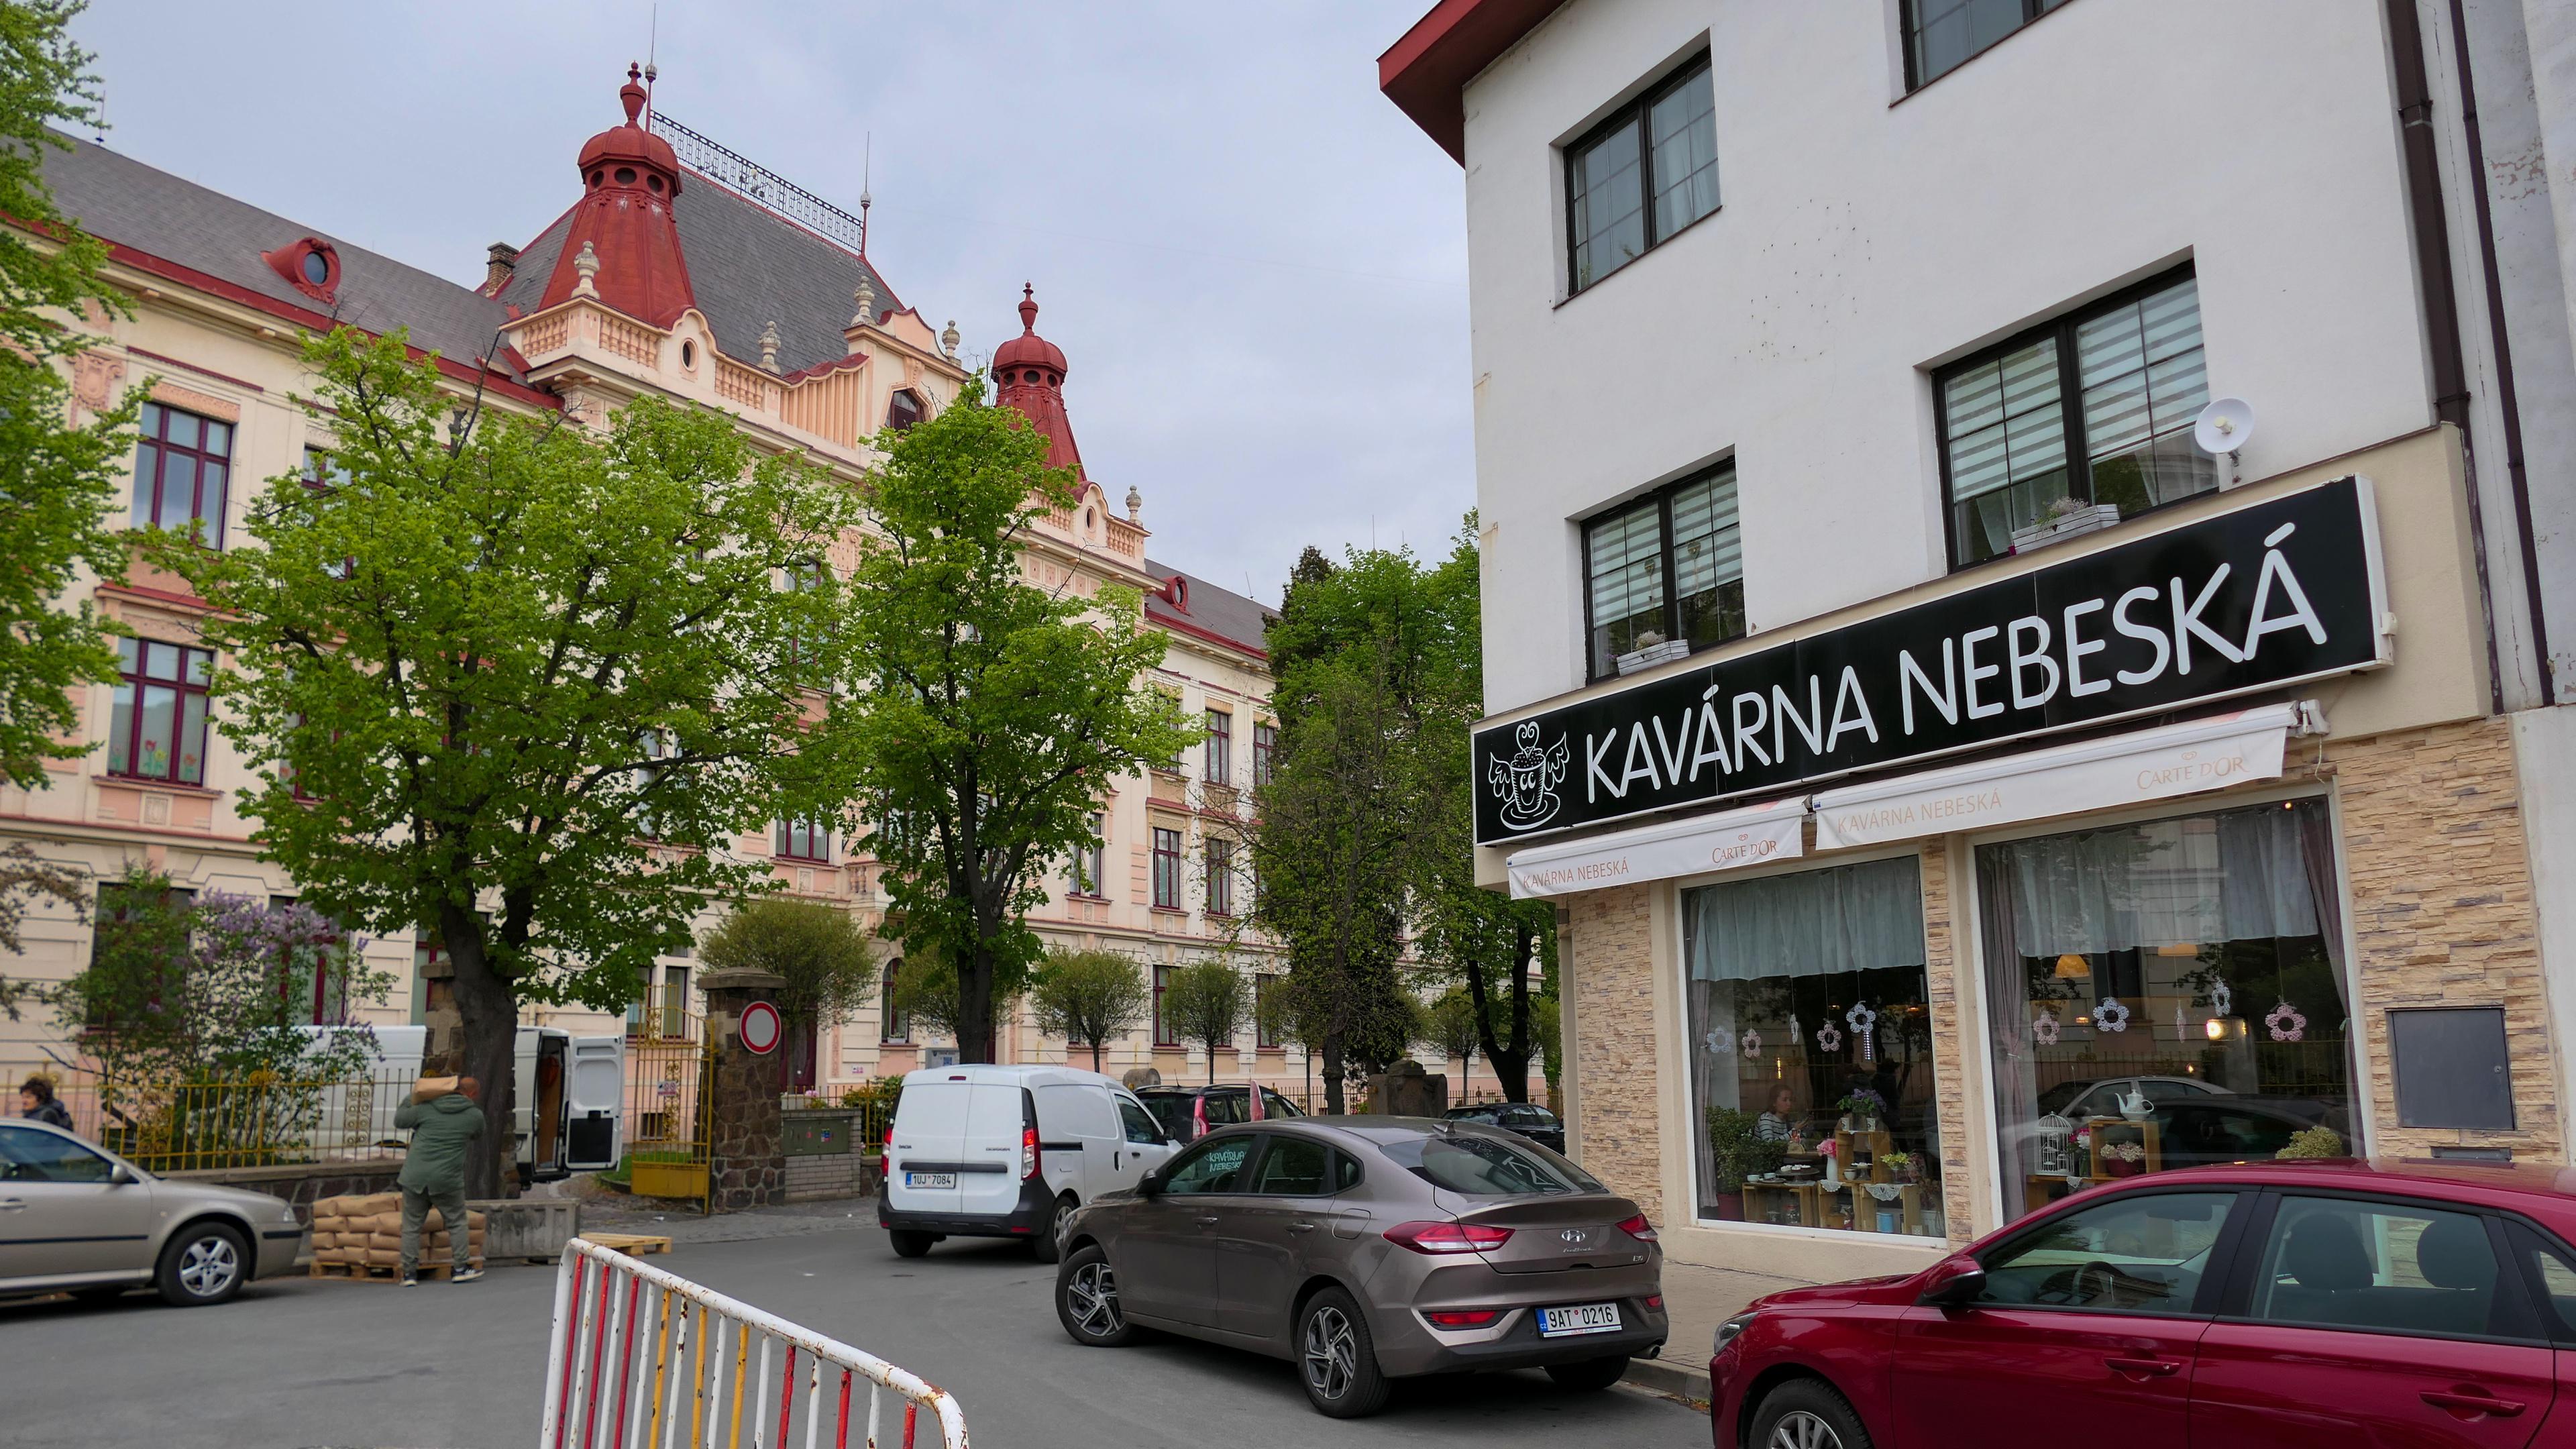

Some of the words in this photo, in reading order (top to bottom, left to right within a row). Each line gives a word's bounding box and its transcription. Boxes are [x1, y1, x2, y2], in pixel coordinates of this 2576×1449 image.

[1587, 665, 1878, 804] KAVÁRNA
[1899, 522, 2328, 735] NEBESKÁ
[2137, 765, 2193, 790] CARTE
[2200, 757, 2251, 776] D'OR
[1838, 806, 1915, 833] KAVÁRNA
[1921, 788, 2002, 820] NEBESKÁ
[1713, 845, 1746, 863] CARTE
[1750, 840, 1778, 855] D'OR
[1523, 869, 1574, 889] KAVÁRNA
[1578, 857, 1629, 881] NEBESKÁ
[914, 1175, 926, 1185] 1UJ
[932, 1175, 951, 1185] 7084
[1210, 1161, 1242, 1172] NEBESK
[1549, 1310, 1571, 1328] 9AT
[1582, 1306, 1613, 1324] 0216
